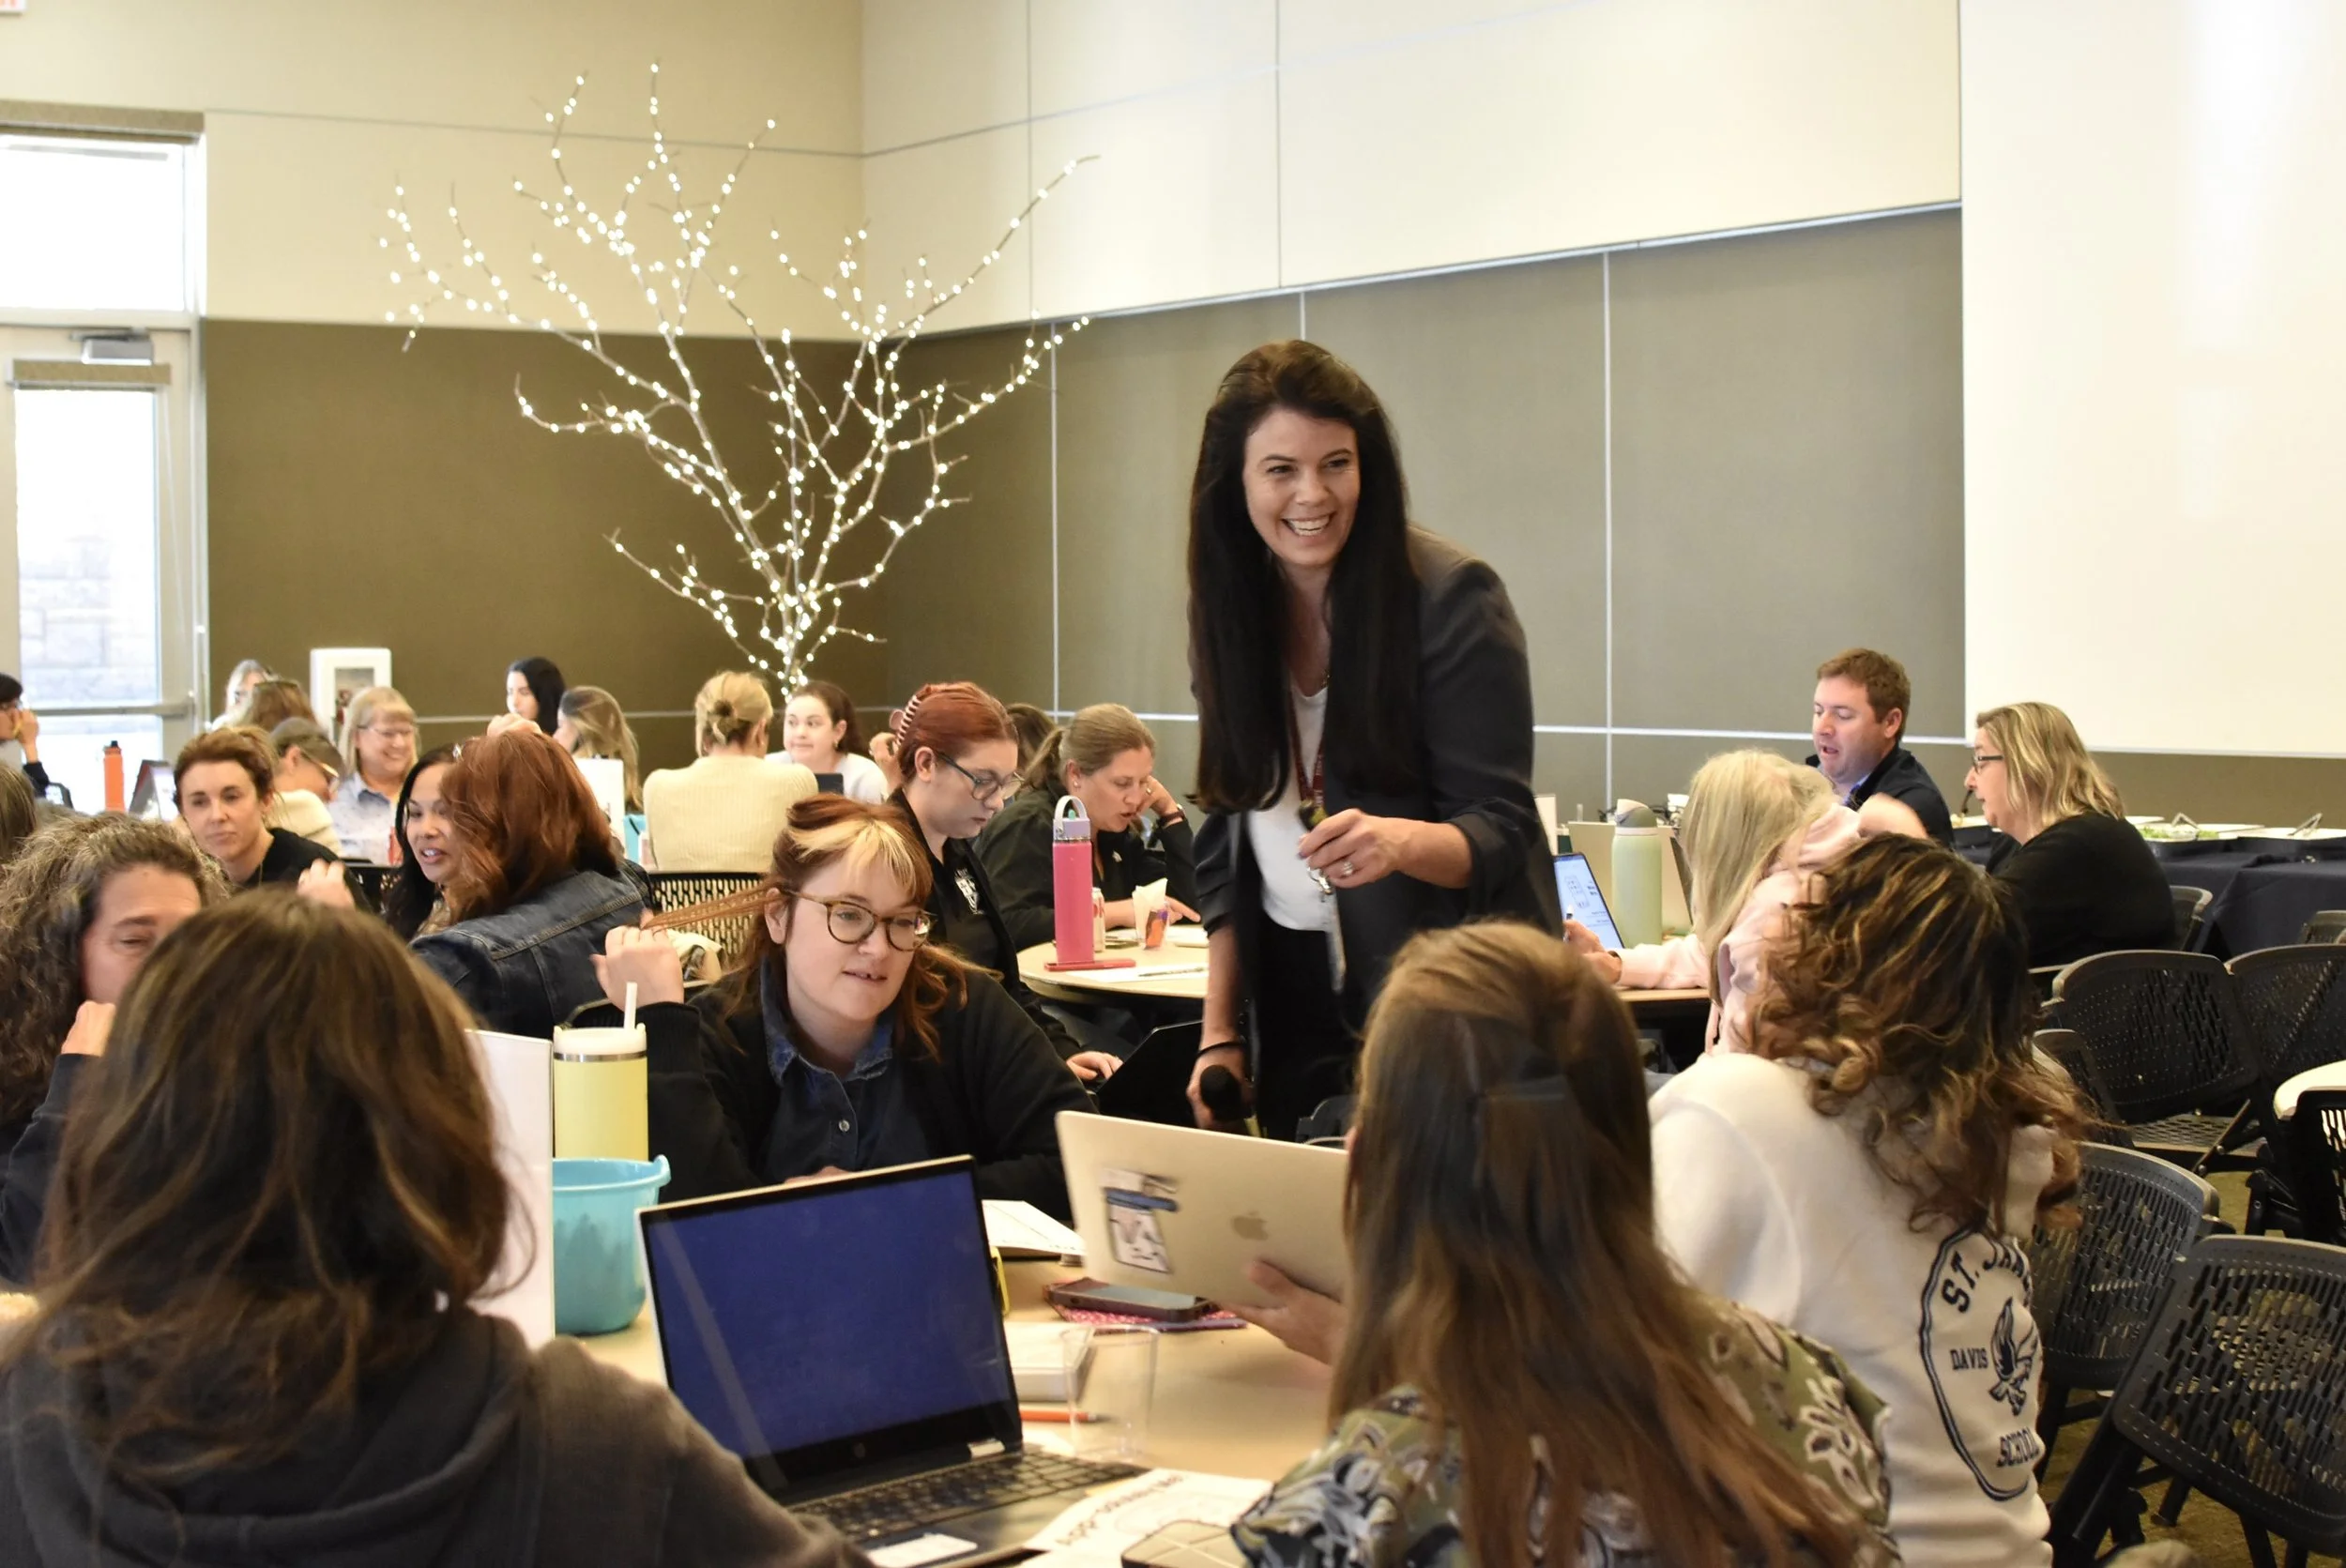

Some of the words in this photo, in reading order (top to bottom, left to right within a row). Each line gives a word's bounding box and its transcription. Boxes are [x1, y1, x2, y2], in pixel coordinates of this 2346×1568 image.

[1942, 1251, 1979, 1313] ST.
[1950, 1347, 1988, 1370] DAVIS
[1996, 1426, 2039, 1468] SCHOOL
